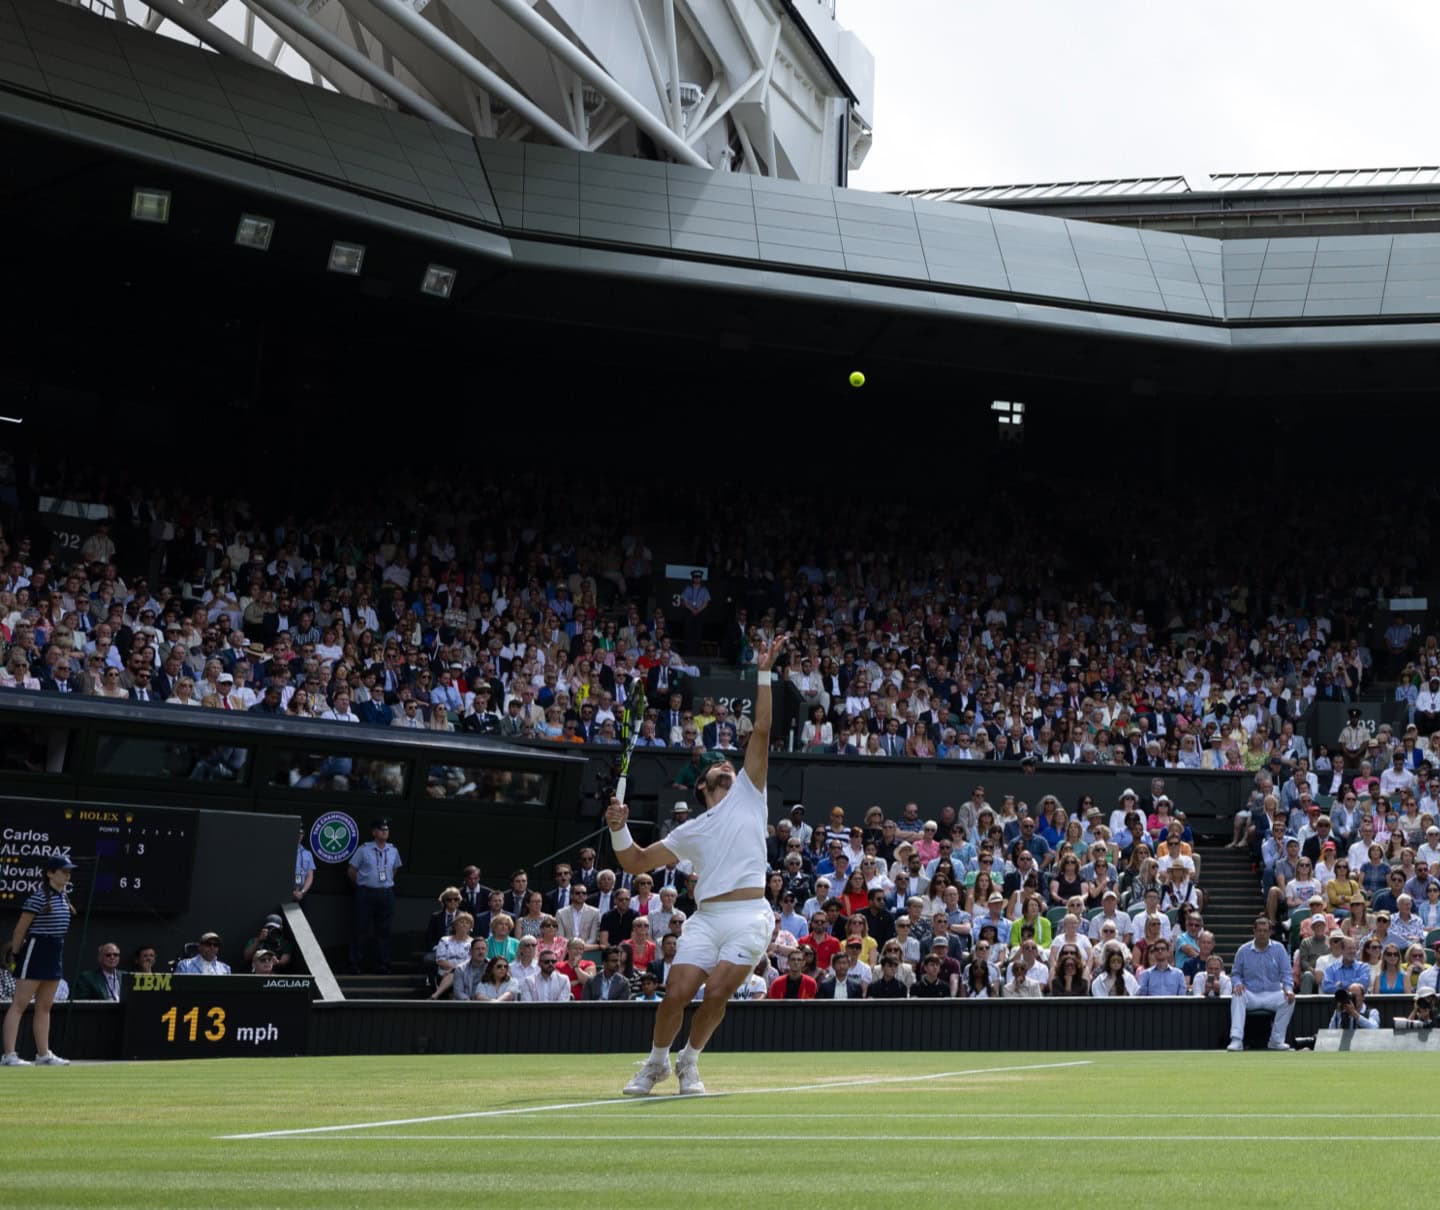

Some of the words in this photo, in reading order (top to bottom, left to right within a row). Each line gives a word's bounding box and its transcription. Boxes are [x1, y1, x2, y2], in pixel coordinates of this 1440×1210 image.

[80, 811, 119, 821] ROLEX
[3, 828, 49, 842] Carlos
[0, 843, 72, 858] ALCARAZ
[137, 843, 145, 855] 3
[120, 877, 127, 889] 6
[133, 878, 141, 889] 3
[133, 974, 172, 991] IBM
[263, 979, 311, 988] JAGUAR
[161, 1006, 226, 1042] 113
[236, 1023, 279, 1045] mph
